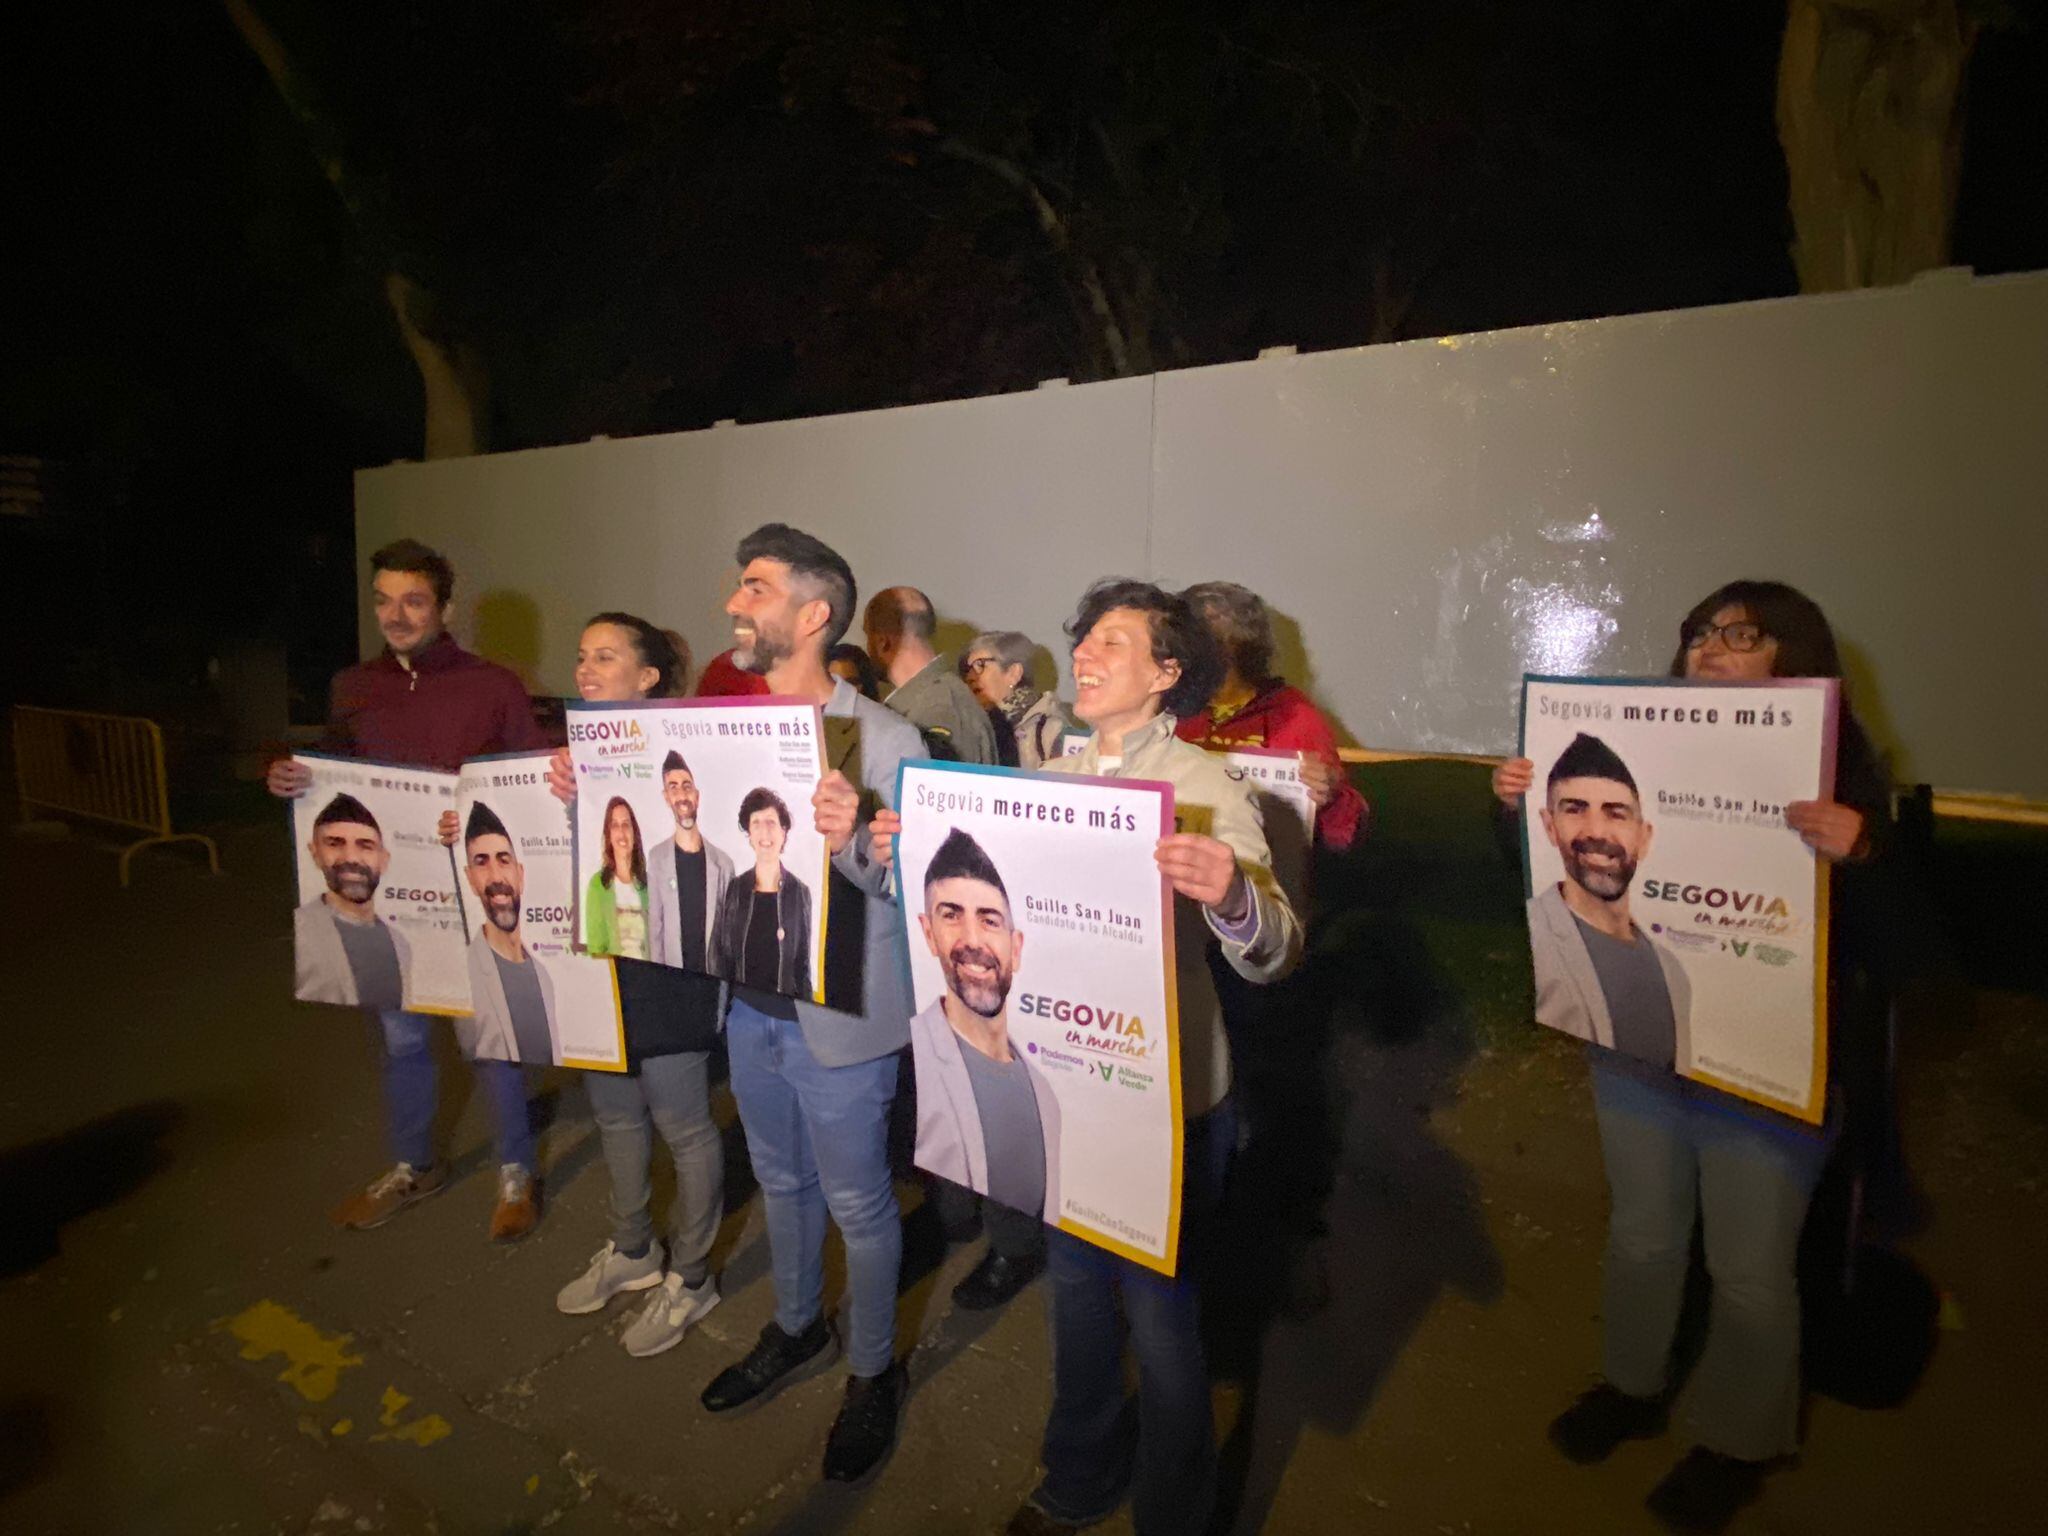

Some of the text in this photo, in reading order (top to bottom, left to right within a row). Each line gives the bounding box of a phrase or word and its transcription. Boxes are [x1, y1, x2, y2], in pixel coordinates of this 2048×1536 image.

[1540, 696, 1793, 727] Segovia merece más
[569, 719, 642, 741] SEGOVIA
[662, 717, 810, 739] Segovia merece más
[598, 745, 608, 755] en
[493, 773, 537, 787] merece
[1275, 767, 1296, 781] má
[916, 784, 1136, 831] Segovia merece más
[385, 887, 458, 903] SEGOV
[1643, 879, 1788, 917] SEGOVIA
[526, 906, 573, 922] SEGOV
[1026, 895, 1141, 929] Guille San Juan
[1026, 911, 1076, 930] Candidato
[1089, 922, 1098, 934] la
[1019, 993, 1145, 1039] SEGOVIA
[1065, 1030, 1082, 1044] en
[1040, 1047, 1084, 1066] Podemos
[1117, 1066, 1154, 1083] Alianza
[1118, 1076, 1148, 1091] Verde
